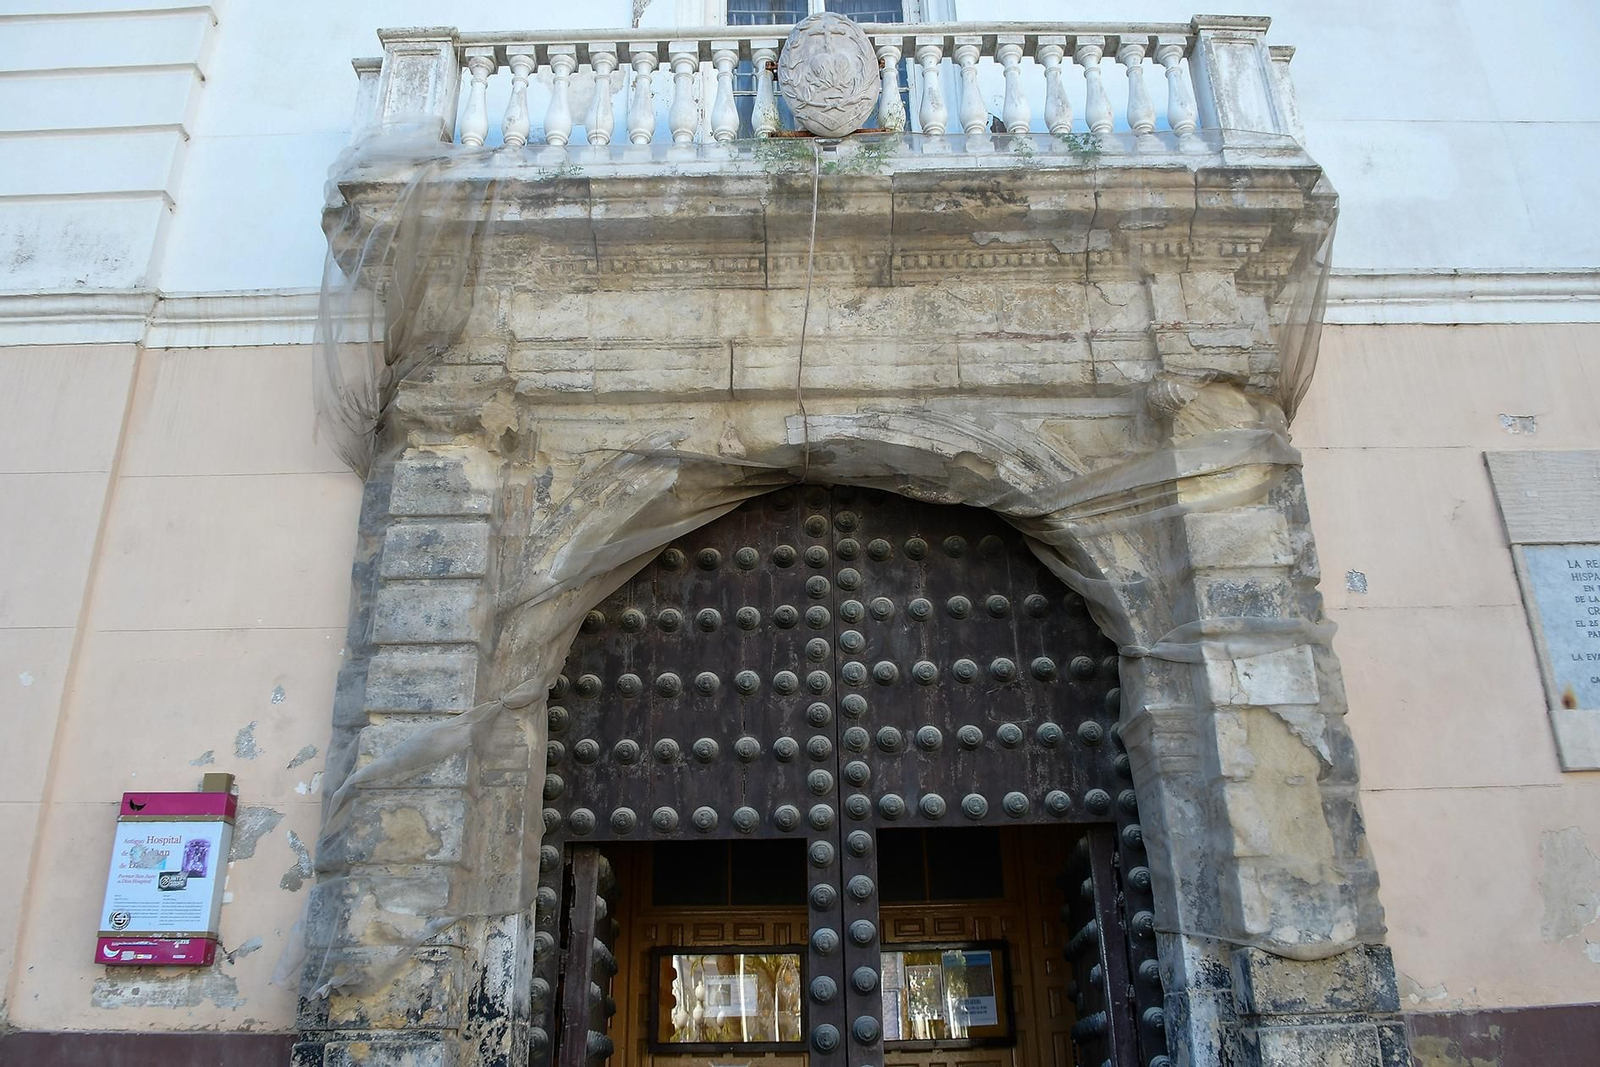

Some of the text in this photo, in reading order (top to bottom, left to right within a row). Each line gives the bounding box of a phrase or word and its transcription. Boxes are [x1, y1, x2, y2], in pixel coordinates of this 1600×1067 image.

[1567, 559, 1582, 569] LA
[1575, 620, 1586, 628] EL
[1571, 653, 1584, 661] LA
[146, 835, 182, 846] Hospital
